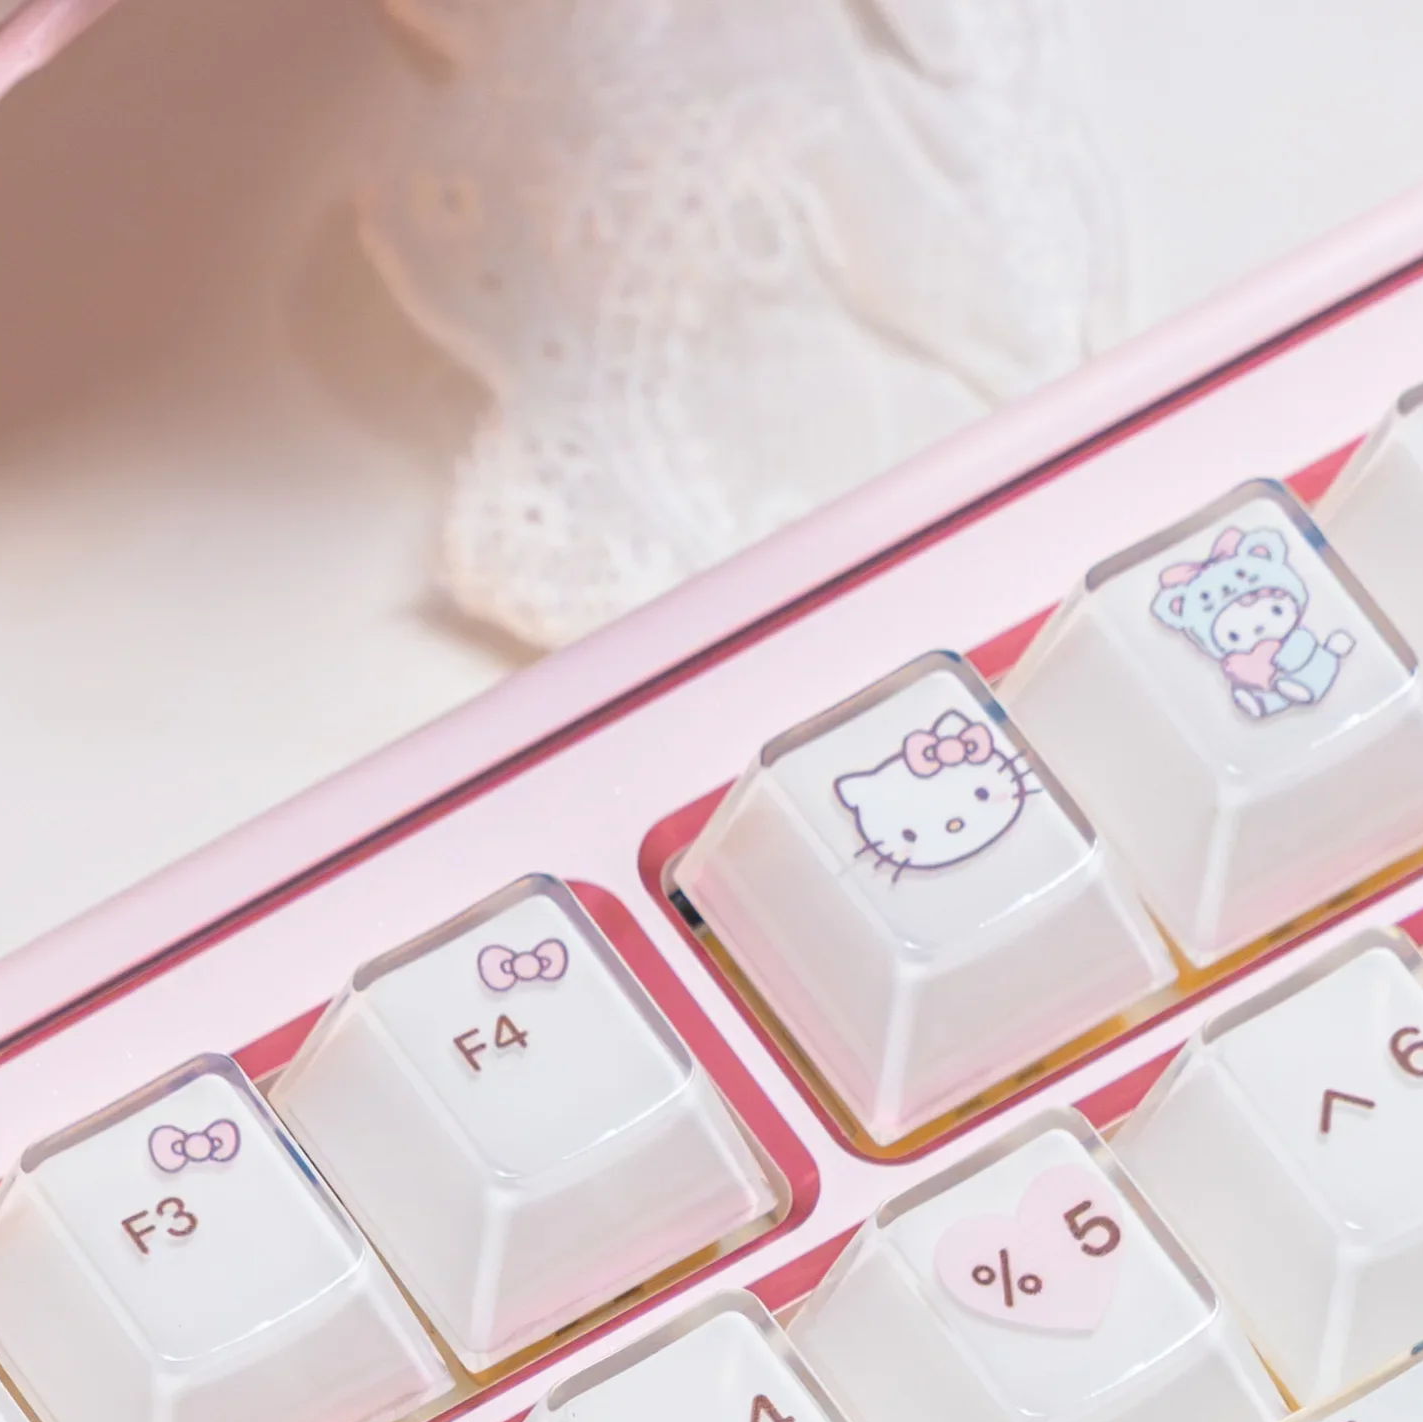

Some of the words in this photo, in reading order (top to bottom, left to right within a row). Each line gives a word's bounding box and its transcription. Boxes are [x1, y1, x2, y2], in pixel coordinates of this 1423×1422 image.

[452, 1013, 529, 1073] F4
[120, 1195, 199, 1256] F3
[970, 1247, 1044, 1309] %
[1062, 1198, 1122, 1258] 5
